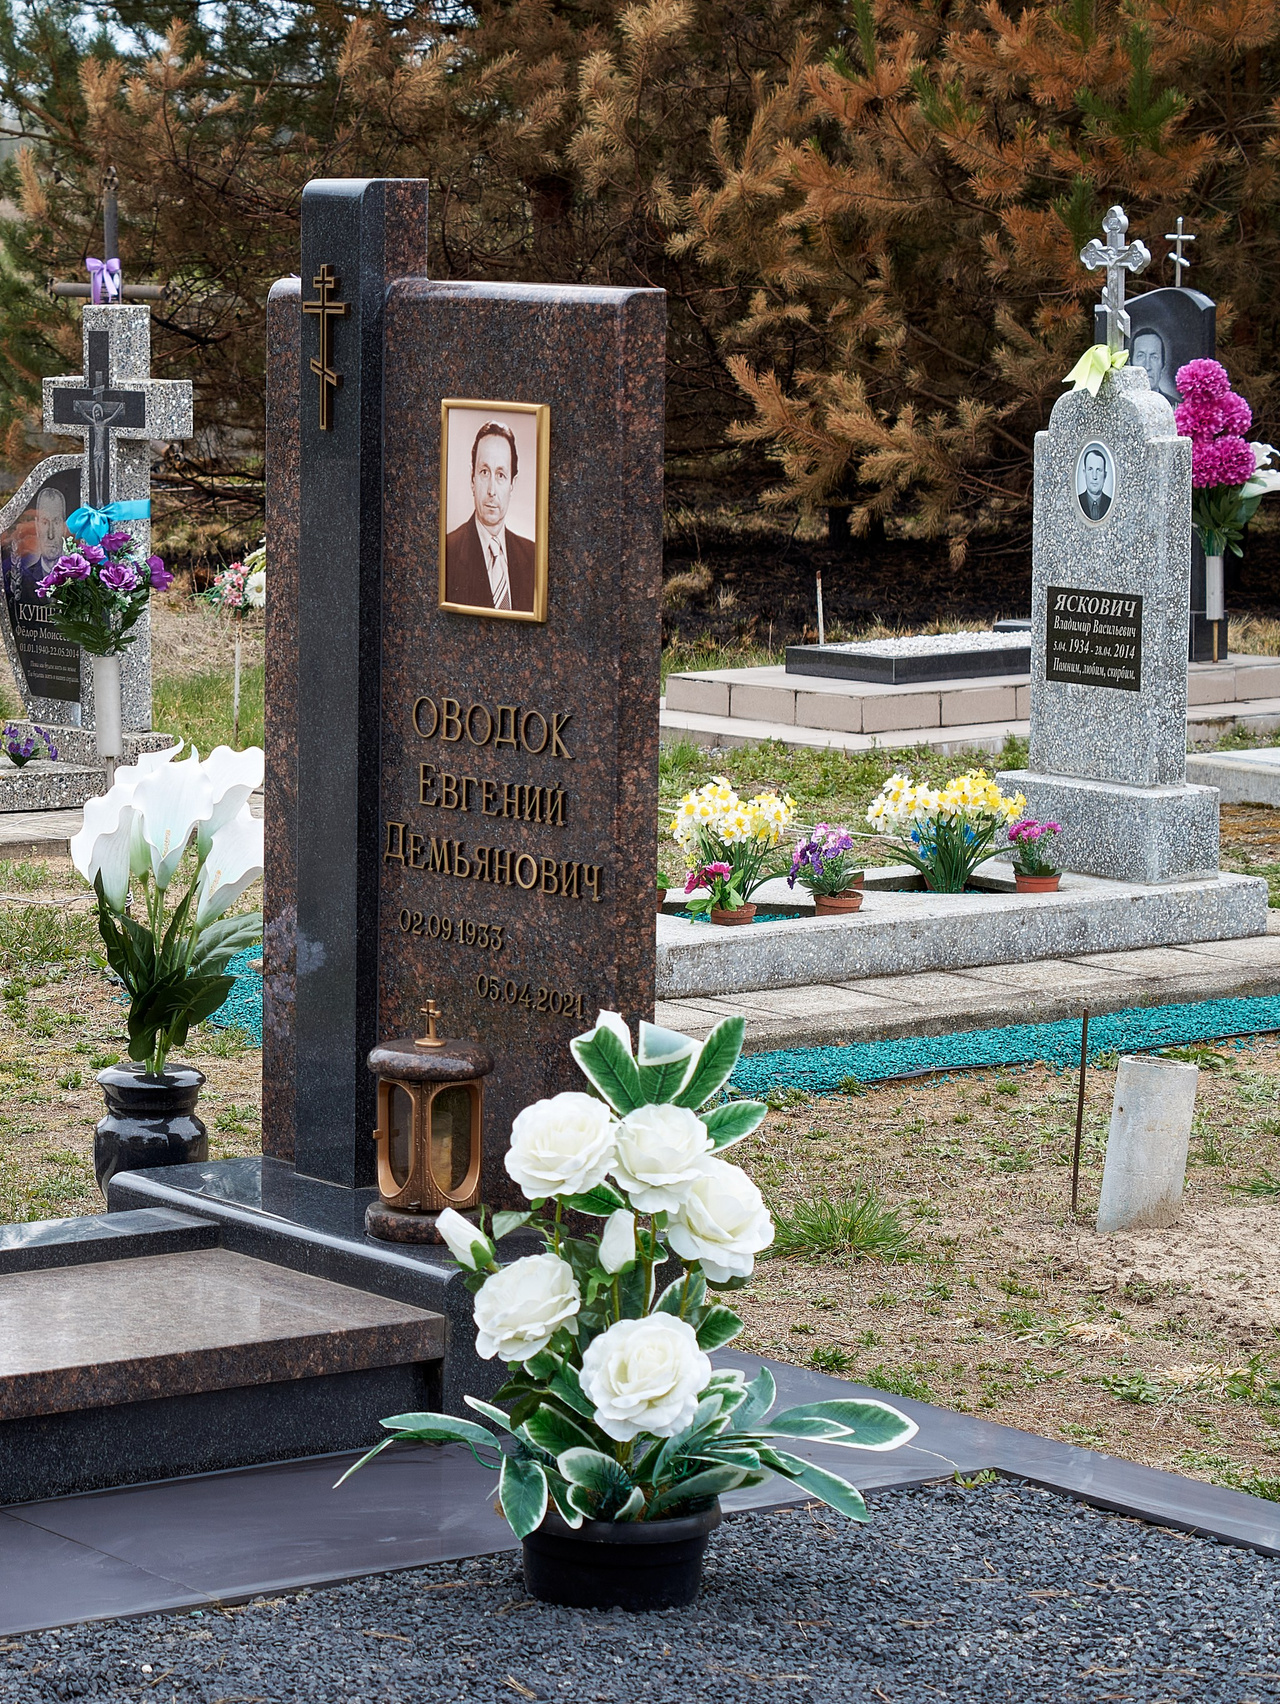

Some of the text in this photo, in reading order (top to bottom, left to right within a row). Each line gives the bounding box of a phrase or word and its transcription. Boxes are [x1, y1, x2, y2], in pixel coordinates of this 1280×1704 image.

[1053, 594, 1137, 618] ЯСКОВИЧ
[1053, 615, 1137, 638] Владимир Васильевич
[1069, 638, 1090, 654] 1934
[1113, 643, 1136, 659] 2014
[1053, 657, 1082, 676] Помним,
[412, 696, 576, 760] ОВОДОК
